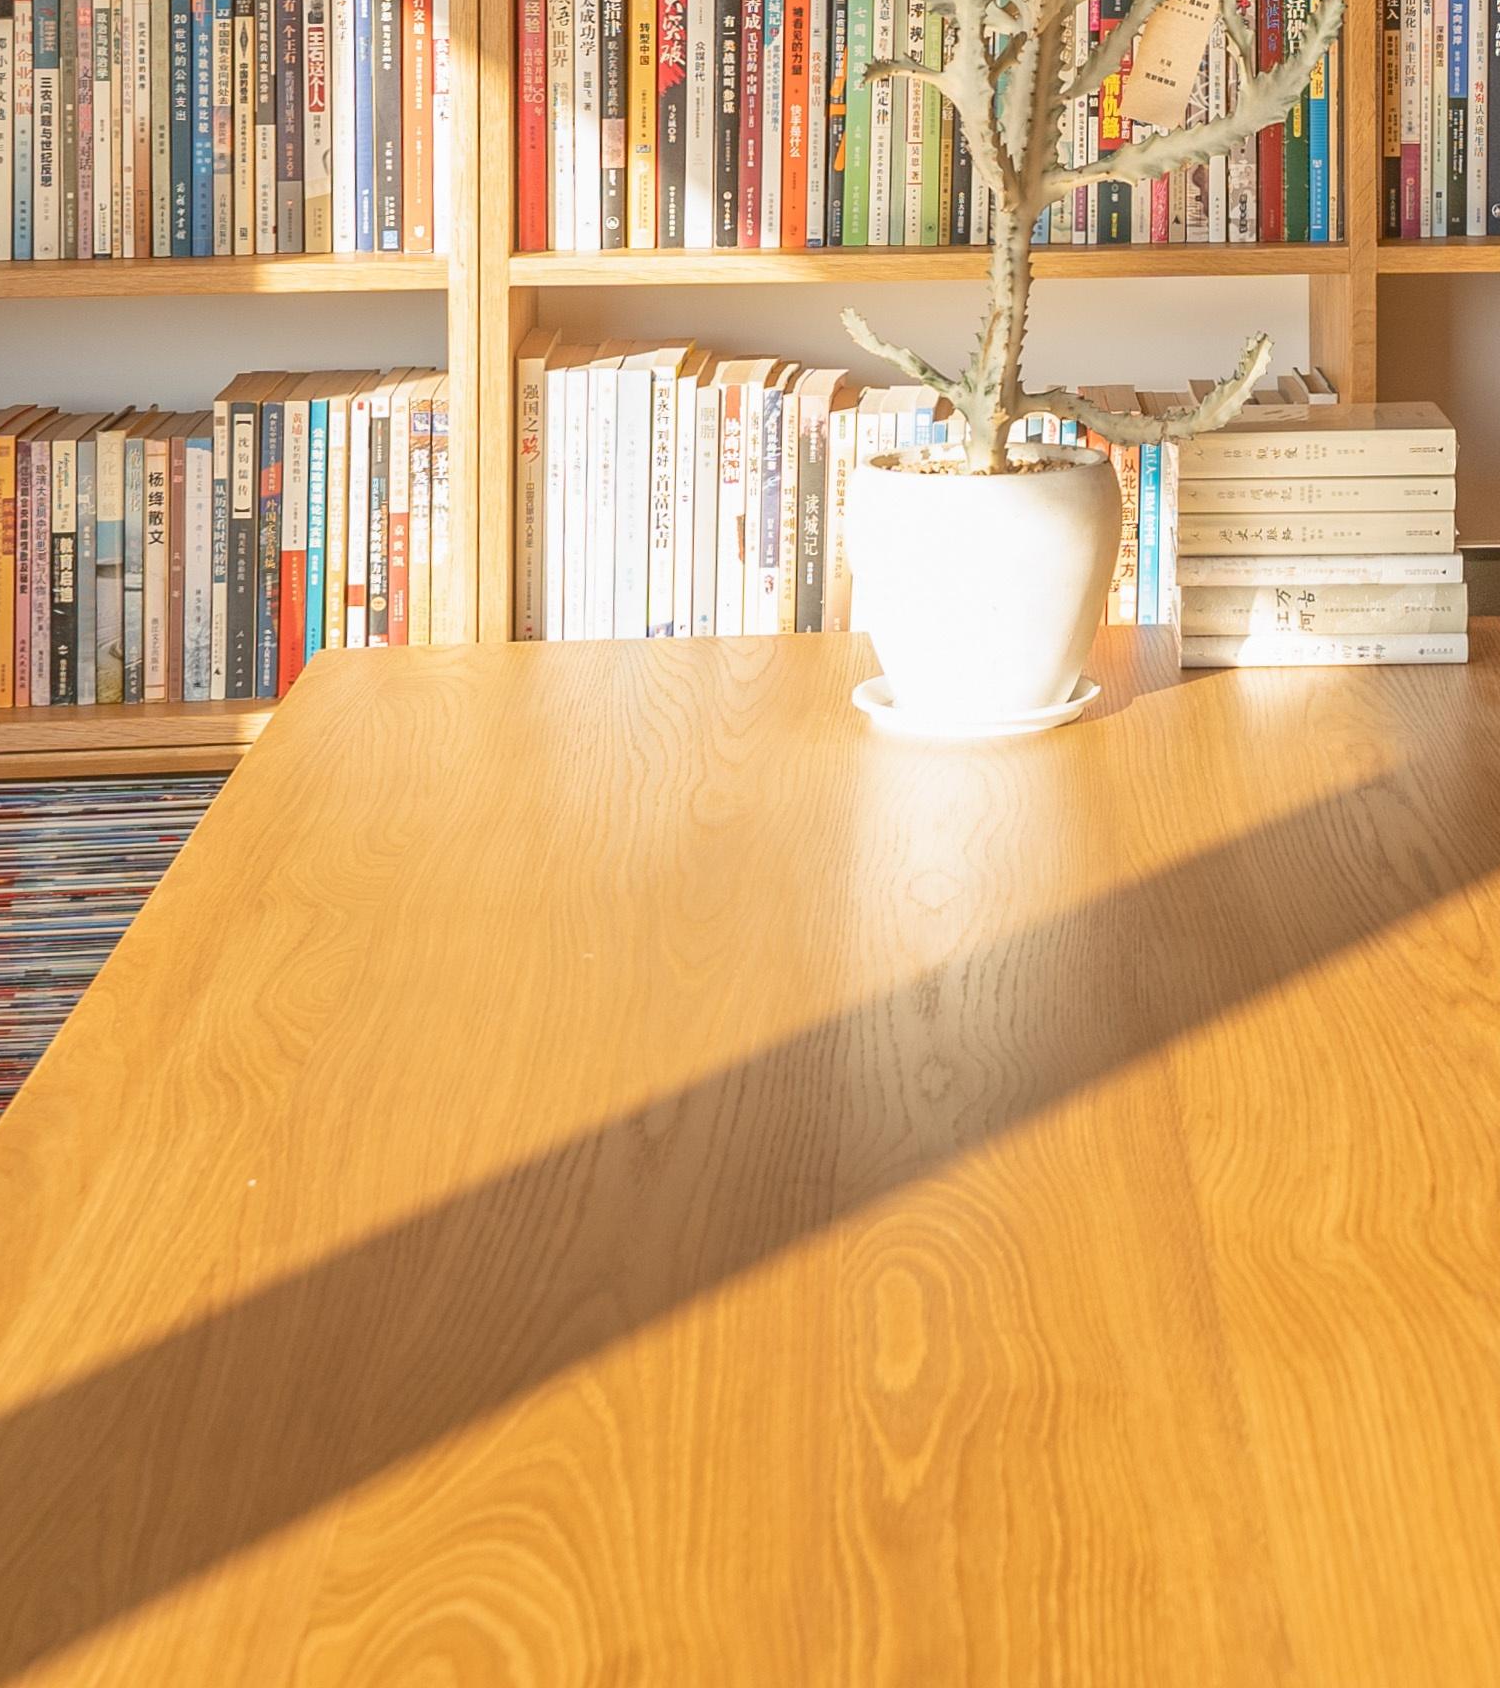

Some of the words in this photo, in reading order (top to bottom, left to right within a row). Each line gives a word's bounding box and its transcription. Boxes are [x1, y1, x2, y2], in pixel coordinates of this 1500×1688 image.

[309, 29, 325, 108] 王石这个人
[804, 494, 819, 556] 读城记
